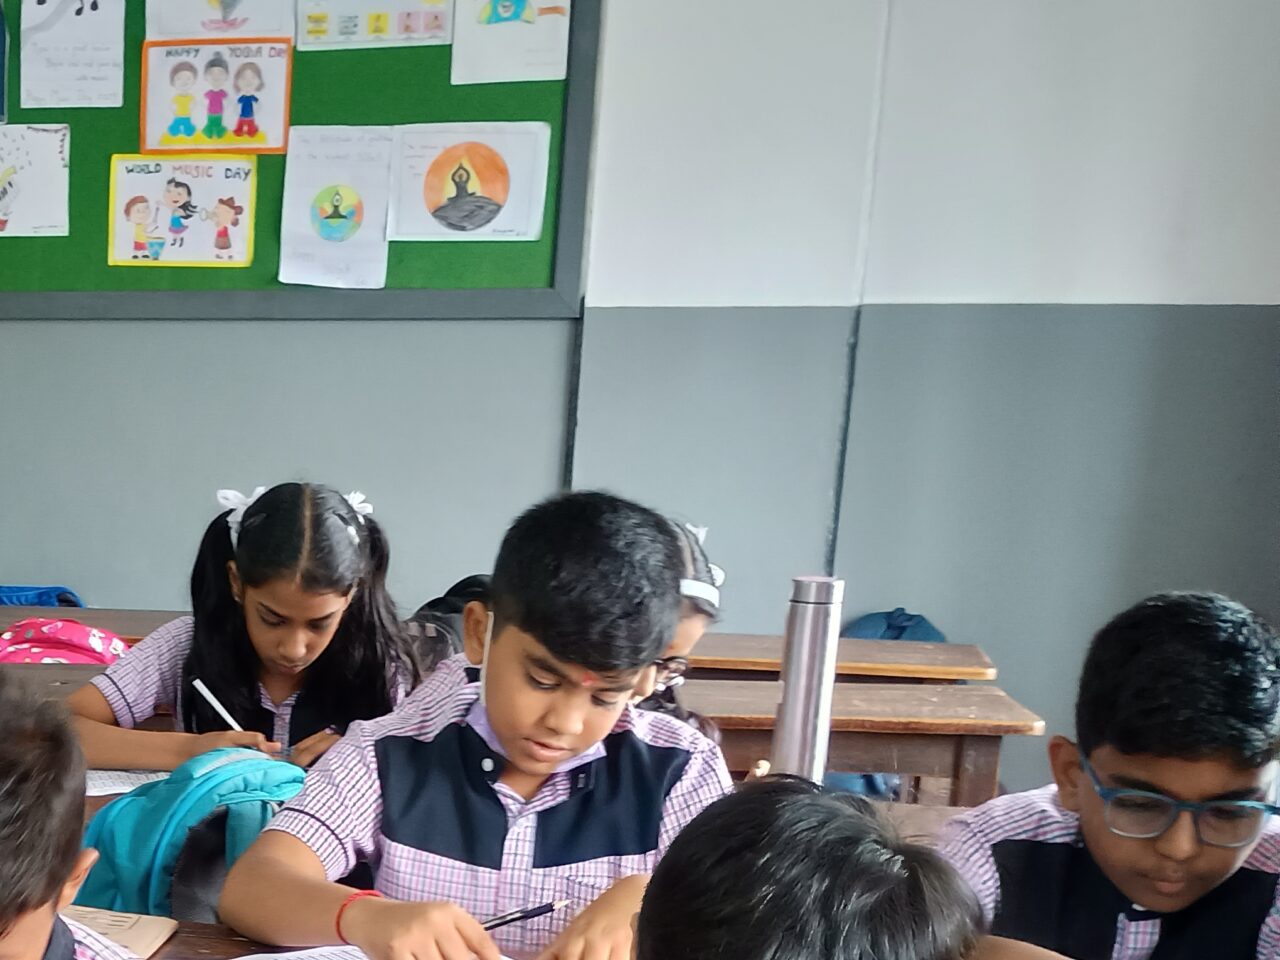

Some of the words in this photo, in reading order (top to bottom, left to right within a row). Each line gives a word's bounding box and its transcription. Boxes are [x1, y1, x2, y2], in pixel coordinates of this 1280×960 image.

[228, 46, 262, 58] YOGA
[125, 163, 163, 174] WORLD
[171, 164, 214, 178] MUSIC
[224, 167, 252, 181] DAY
